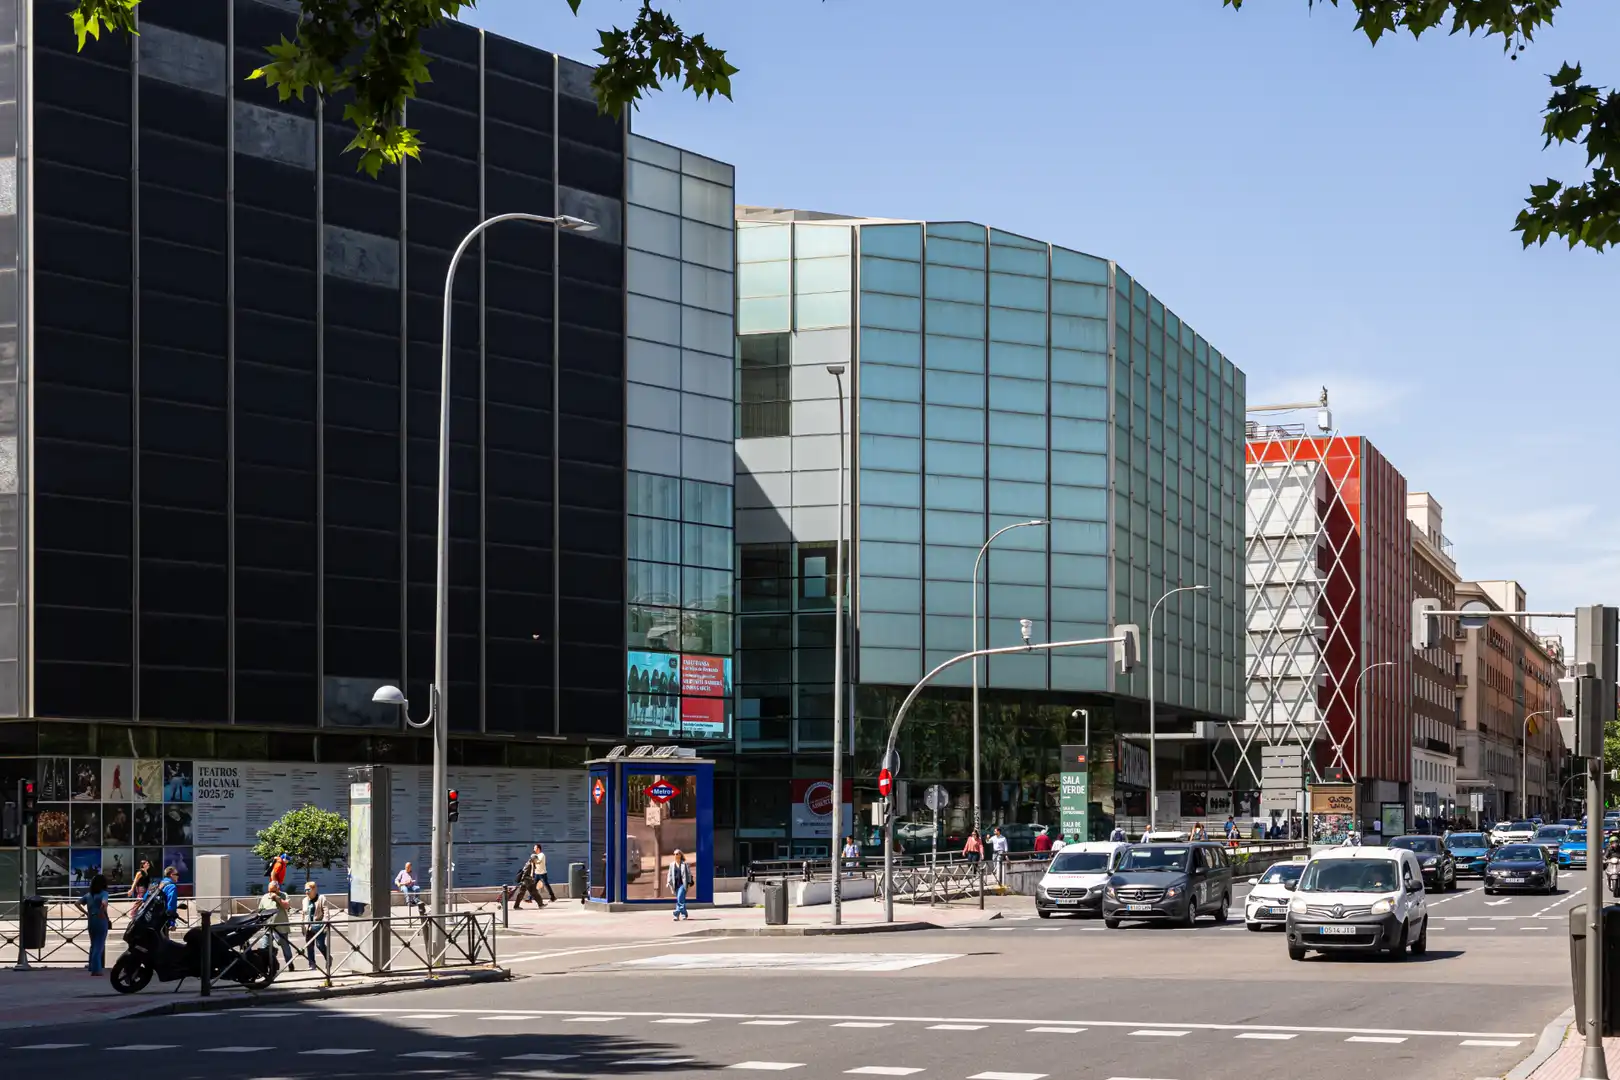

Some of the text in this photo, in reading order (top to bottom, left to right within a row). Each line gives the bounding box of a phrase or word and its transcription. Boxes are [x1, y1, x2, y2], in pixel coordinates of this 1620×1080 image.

[199, 767, 238, 777] TEATROS
[198, 777, 241, 788] del CANAL
[1062, 775, 1080, 785] SALA
[198, 789, 235, 799] 2025/26
[1062, 785, 1085, 794] VERDE
[1325, 926, 1341, 934] 0514
